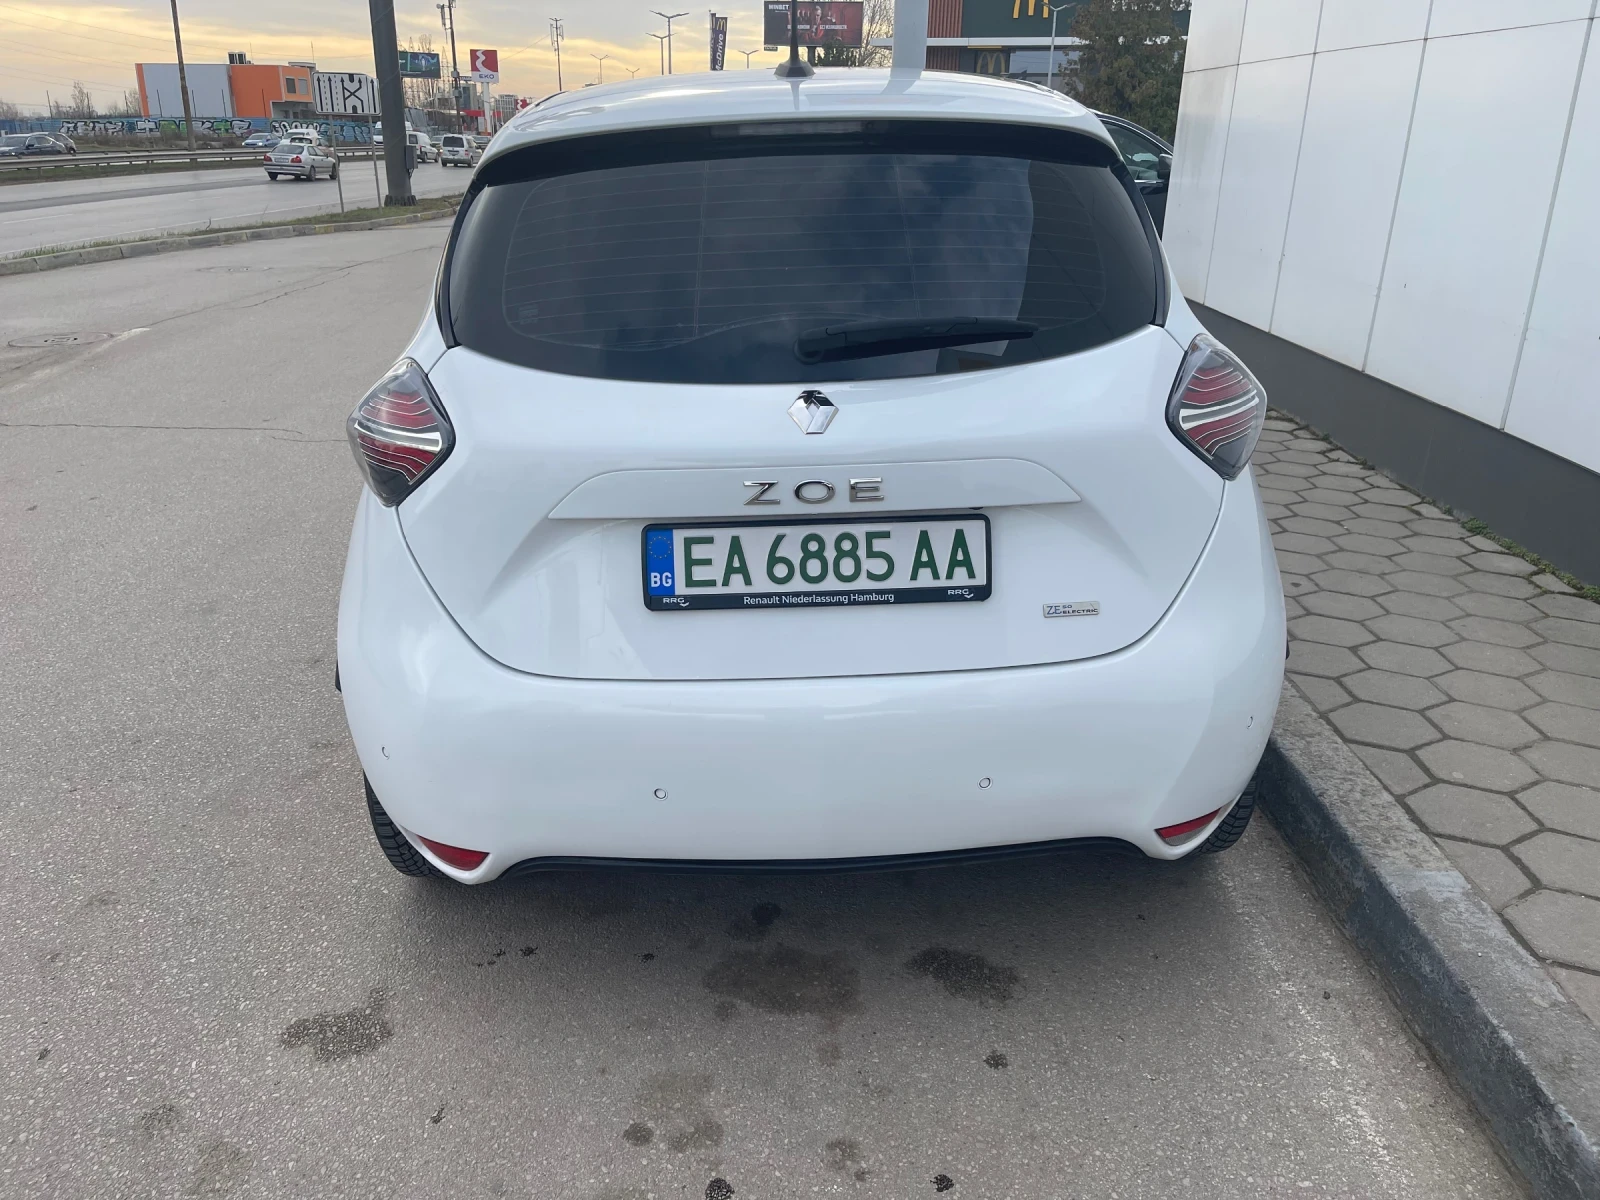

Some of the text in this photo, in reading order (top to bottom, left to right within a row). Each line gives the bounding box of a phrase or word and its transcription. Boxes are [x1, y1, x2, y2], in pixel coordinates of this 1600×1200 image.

[743, 477, 885, 505] ZOE
[683, 528, 977, 588] EA 6885 AA
[650, 572, 673, 588] BG
[743, 592, 895, 605] Renault Niederlassung Hamburg
[947, 588, 970, 596] RRG
[662, 597, 685, 605] RRG
